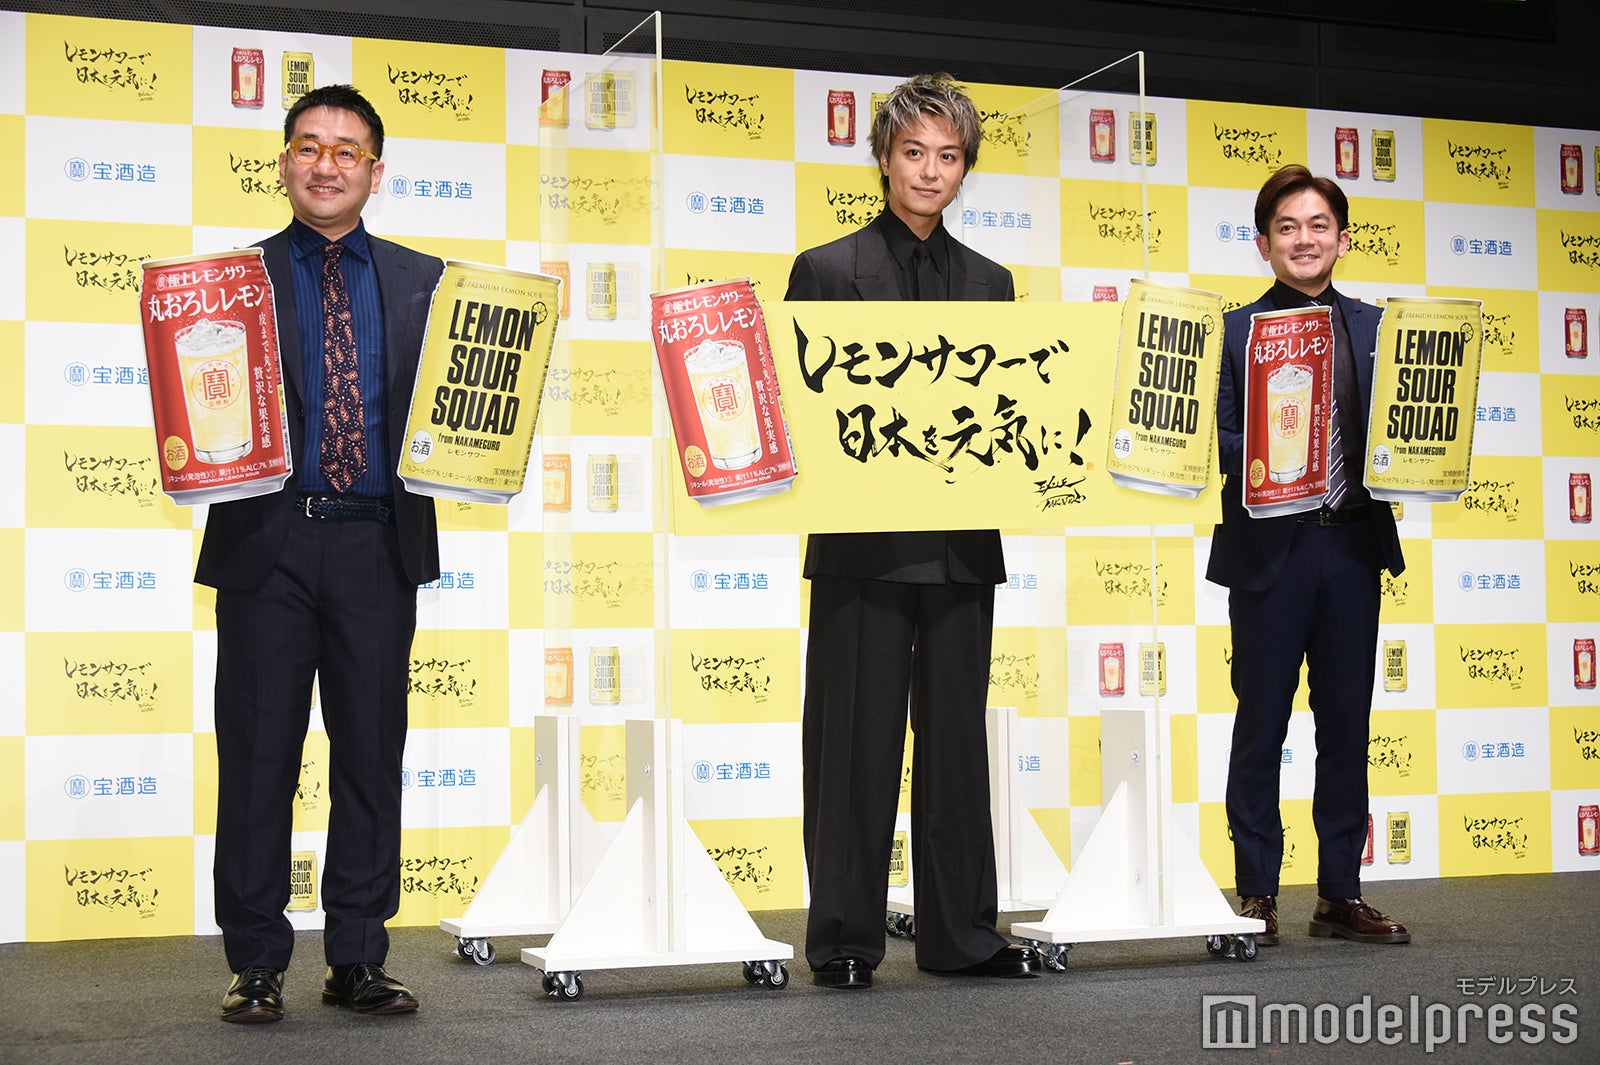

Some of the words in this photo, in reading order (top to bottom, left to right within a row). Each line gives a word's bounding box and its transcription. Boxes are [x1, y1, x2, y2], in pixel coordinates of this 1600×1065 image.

[64, 40, 152, 66] レモンサワーで
[387, 63, 468, 87] レモンサワーで
[685, 84, 759, 106] レモンサワーで
[980, 110, 1027, 125] ンサワーで
[980, 127, 1032, 149] 本を元気に!
[1213, 122, 1278, 143] レモンサワーで
[1448, 139, 1506, 159] レモンサワーで
[93, 161, 156, 182] 宝酒造
[229, 151, 279, 173] レモンサ
[240, 177, 287, 200] 日本を元
[414, 179, 472, 199] 宝酒造
[826, 187, 886, 206] レモンサワー
[711, 195, 764, 215] 宝酒造
[836, 210, 882, 228] 日本を元
[982, 211, 1031, 229] 宝酒造
[1345, 222, 1396, 236] モンサワーで
[1469, 239, 1512, 256] 宝酒造
[1561, 230, 1600, 248] レモンサワ
[1569, 251, 1600, 270] 日本を元
[76, 269, 141, 294] 日本を元気
[167, 265, 252, 288] 極上レモンサワー
[467, 281, 499, 292] PREMIUM
[501, 286, 525, 296] LEMON
[526, 291, 543, 299] SOUR
[147, 284, 265, 323] 丸おろしレモン
[673, 291, 744, 313] 極上レモンサワー
[448, 299, 537, 352] LEMON
[658, 307, 757, 346] 丸おろしレモン
[1137, 312, 1207, 359] LEMON
[792, 316, 1070, 393] レモンサワーで
[1253, 336, 1329, 365] 丸おろしレモン
[1394, 329, 1466, 367] LEMON
[93, 366, 149, 385] 宝酒造
[447, 344, 522, 393] SOUR
[1139, 351, 1198, 396] SOUR
[1396, 367, 1457, 404] SOUR
[431, 385, 520, 436] SQUAD
[1128, 388, 1199, 435] SQUAD
[1565, 395, 1600, 413] レモンサ
[1386, 404, 1459, 443] SQUAD
[1477, 407, 1516, 422] 宝酒造
[438, 433, 454, 445] from
[454, 436, 501, 451] NAKAMEGURO
[836, 394, 1091, 480] 日本を元気に!
[1136, 431, 1148, 441] from
[1149, 434, 1187, 449] NAKAMEGURO
[166, 444, 187, 461] お酒
[411, 438, 432, 456] お酒
[447, 449, 487, 458] レモンサワー
[1394, 445, 1407, 454] from
[1408, 446, 1446, 456] NAKAMEGURO
[64, 449, 151, 471] レモンサワーで
[199, 477, 224, 485] PREMIUM
[1470, 480, 1515, 493] ンサワーで
[93, 571, 156, 589] 宝酒造
[714, 573, 768, 590] 宝酒造
[1000, 573, 1037, 590] 酒造
[1478, 574, 1521, 590] 宝酒造
[690, 652, 765, 672] レモンサワーで
[1460, 645, 1519, 662] レモンサワーで
[64, 657, 152, 678] レモンサワーで
[409, 659, 471, 675] ンサワーで
[1368, 749, 1412, 768] 本を元気に!
[1482, 742, 1525, 758] 宝酒造
[417, 769, 476, 787] 宝酒造
[716, 763, 770, 780] 宝酒造
[93, 777, 157, 796] 宝酒造
[1464, 814, 1523, 832] レモンサワーで
[707, 846, 767, 861] ンサワーで
[400, 856, 473, 872] モンサワーで
[64, 864, 152, 886] レモンサワーで
